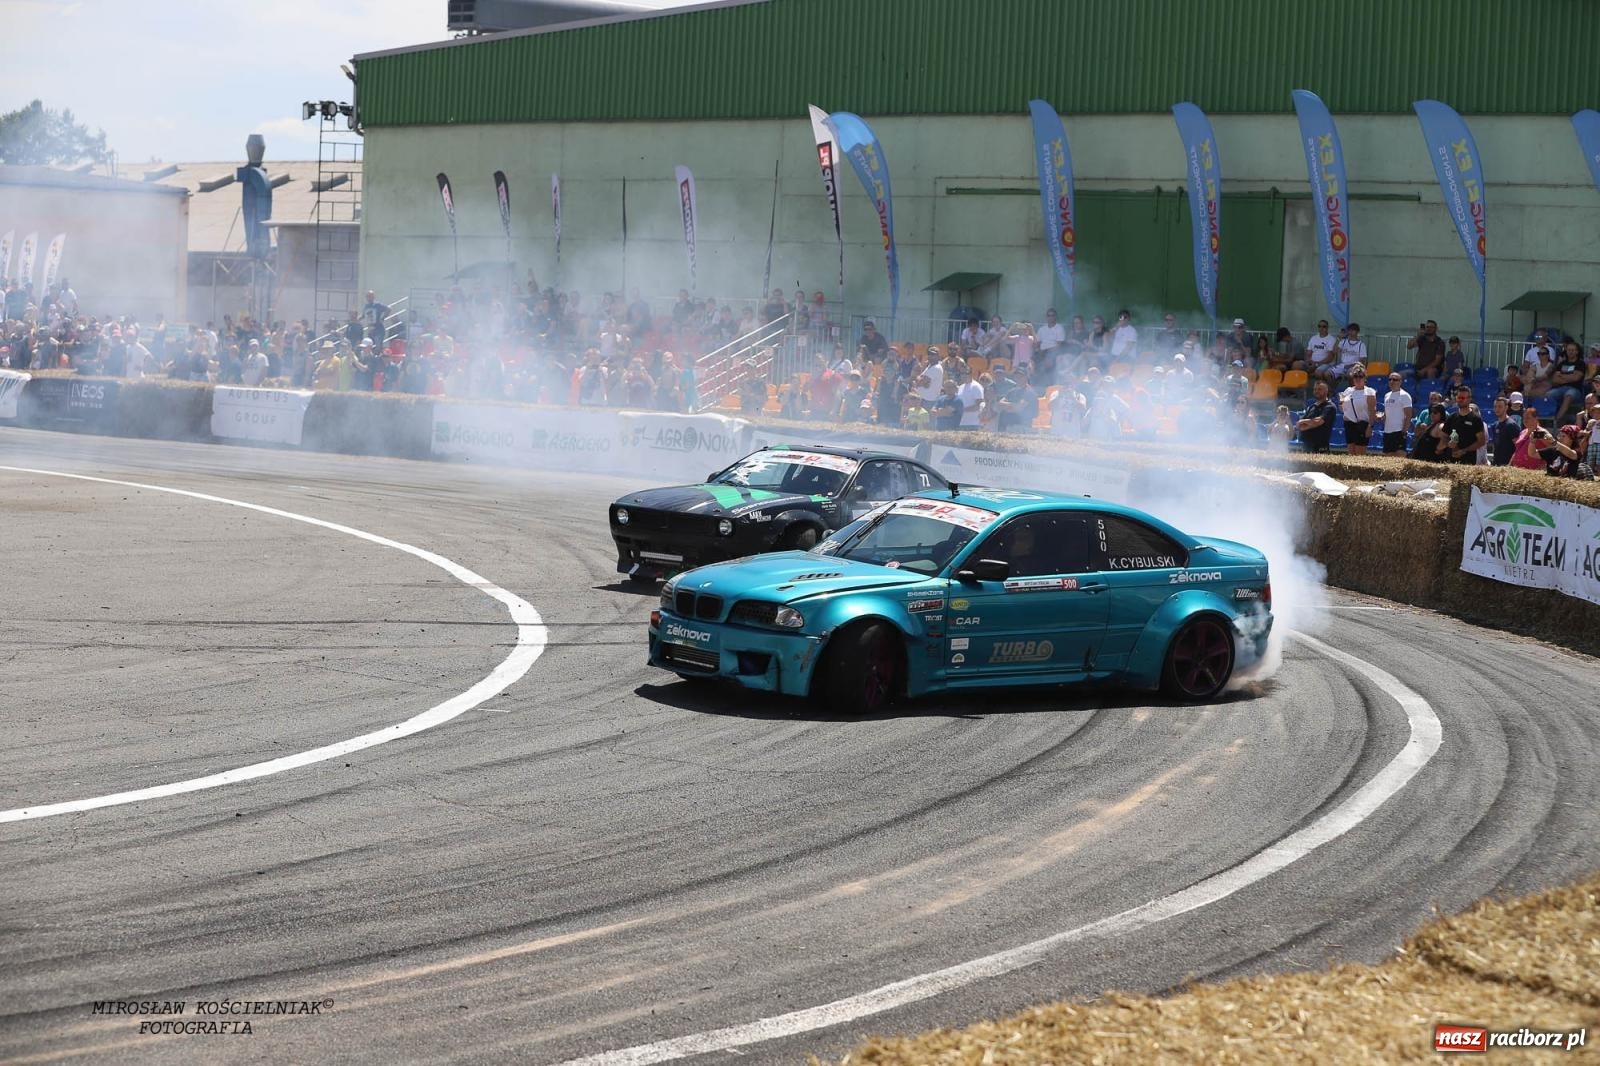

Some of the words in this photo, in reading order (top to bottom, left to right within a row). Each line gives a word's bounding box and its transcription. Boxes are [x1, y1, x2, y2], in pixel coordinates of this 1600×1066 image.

[71, 383, 105, 400] INEOS
[1108, 556, 1176, 569] K.CYBULSKI
[1064, 579, 1077, 589] 500
